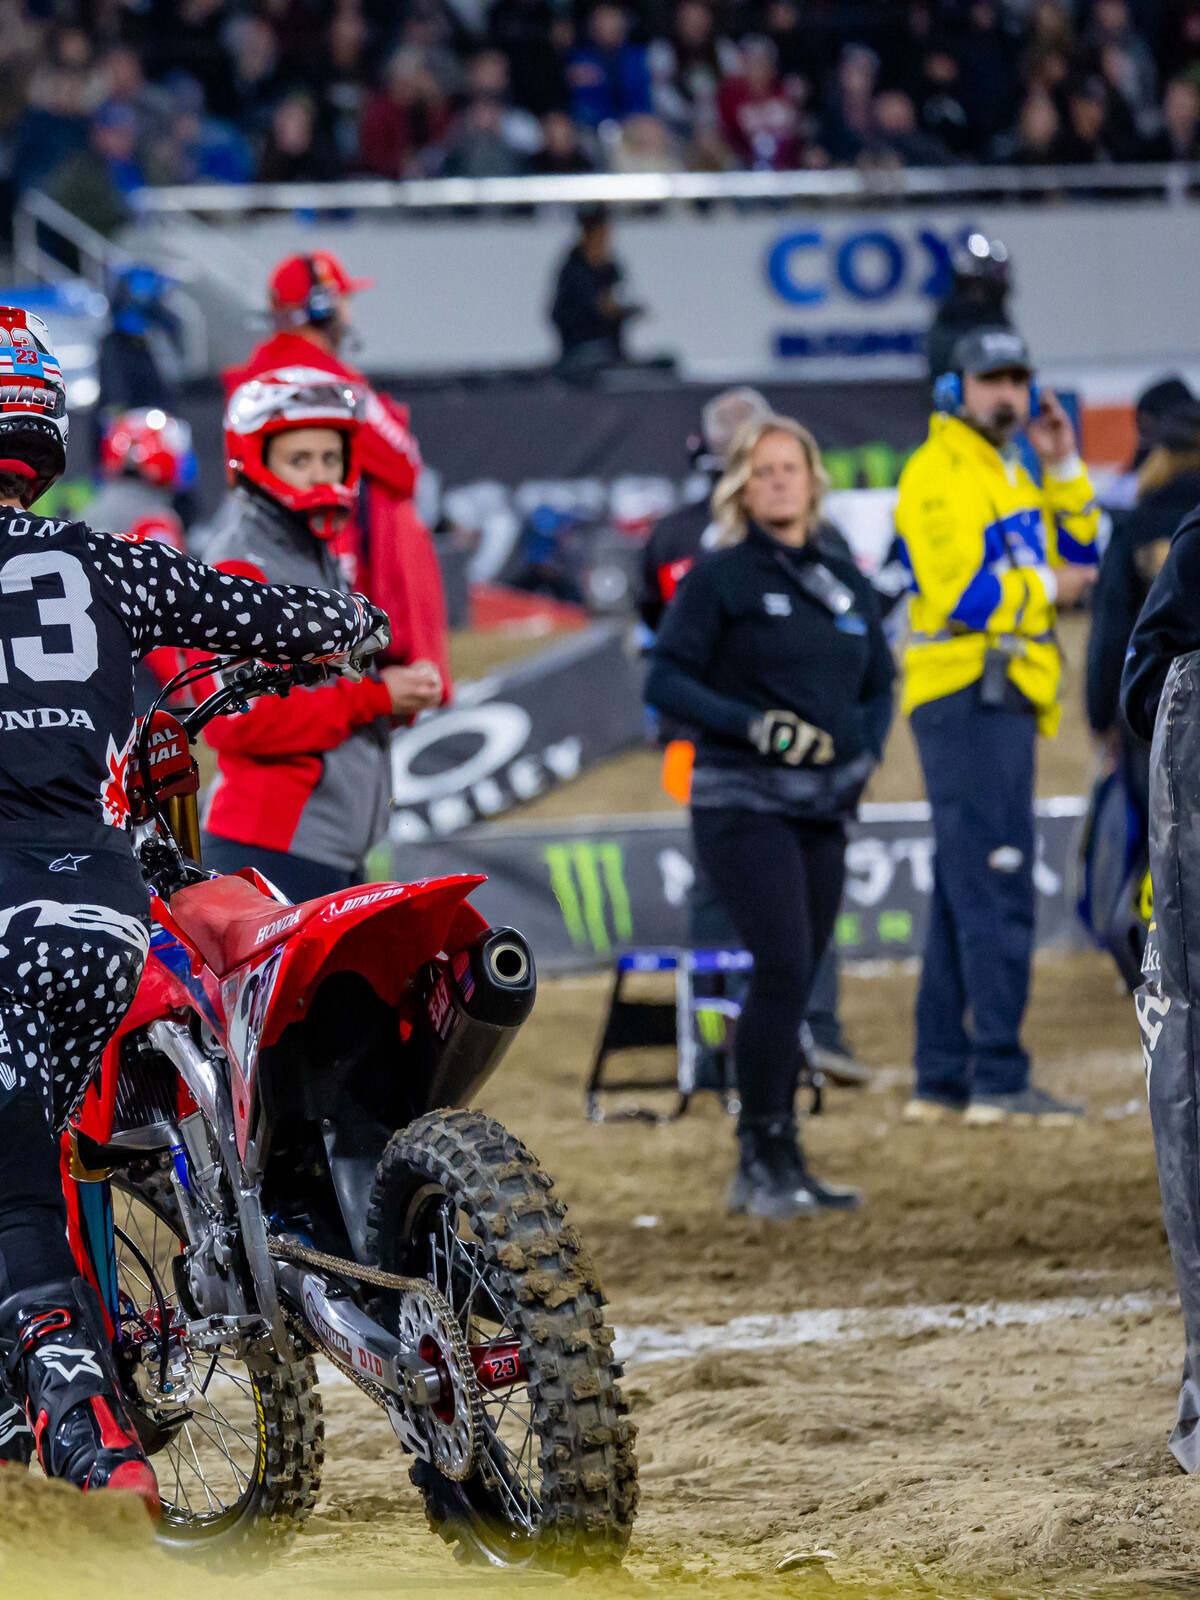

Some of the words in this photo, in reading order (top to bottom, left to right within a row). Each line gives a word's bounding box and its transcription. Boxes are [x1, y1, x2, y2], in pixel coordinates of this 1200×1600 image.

[15, 349, 39, 365] 23
[339, 887, 405, 914] DUNLOP
[254, 908, 302, 946] HONDA
[358, 1346, 383, 1377] DID
[490, 1356, 518, 1382] 23
